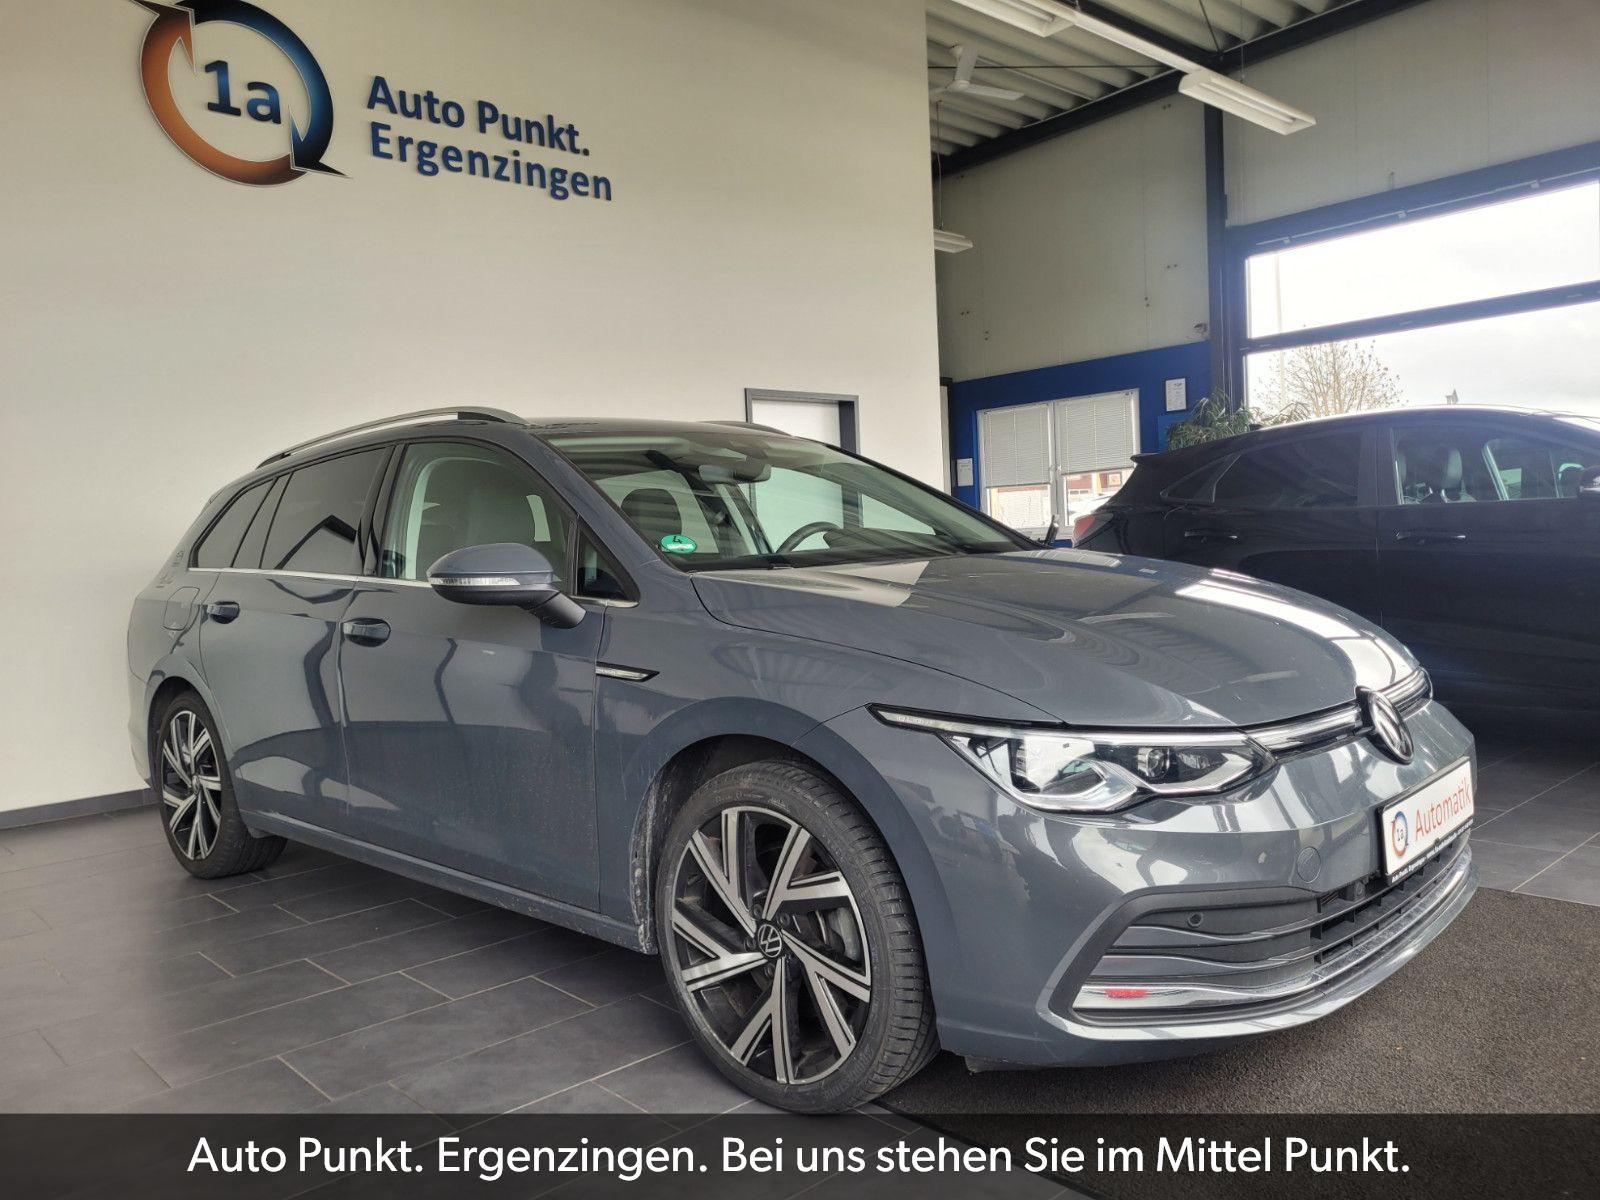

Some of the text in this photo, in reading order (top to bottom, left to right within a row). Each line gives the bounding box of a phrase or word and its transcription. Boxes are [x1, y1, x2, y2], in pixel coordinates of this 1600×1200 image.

[203, 59, 282, 125] 1a
[366, 75, 590, 157] Auto Punkt.
[369, 120, 612, 202] Ergenzingen
[1415, 776, 1471, 842] Automatik
